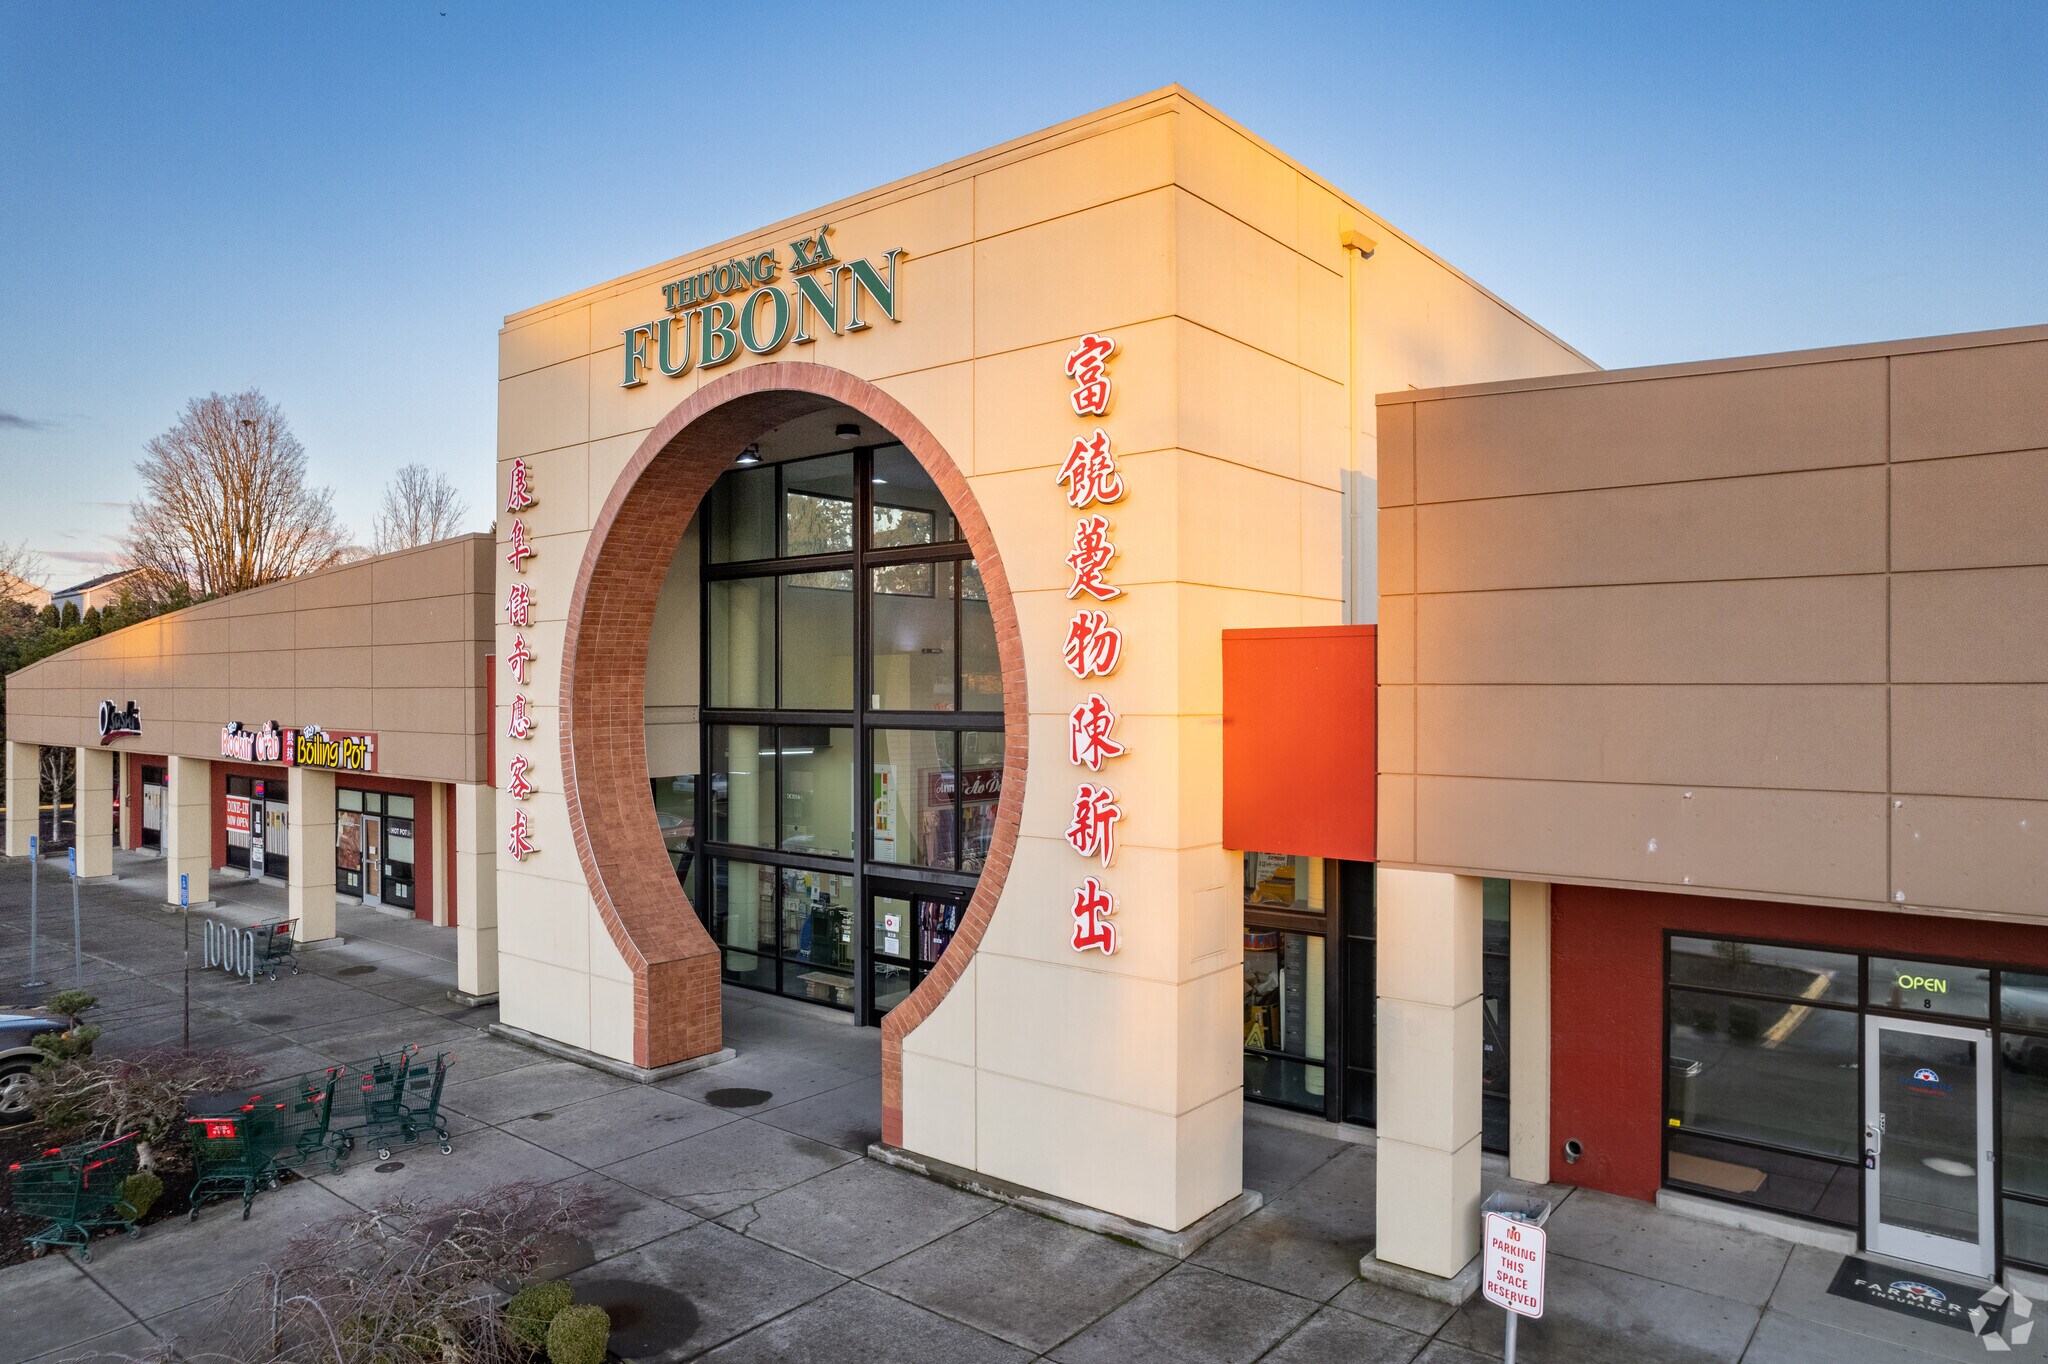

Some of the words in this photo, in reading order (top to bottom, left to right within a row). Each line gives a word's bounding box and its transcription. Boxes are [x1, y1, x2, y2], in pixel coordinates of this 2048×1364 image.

[620, 247, 903, 389] FUBONN
[222, 727, 254, 761] Rockin'
[256, 730, 279, 761] Crab
[297, 733, 339, 768] Boiling
[343, 737, 366, 770] Pot
[227, 800, 249, 815] DINE-IN
[237, 817, 249, 828] OPEN
[1899, 975, 1946, 993] OPEN
[1924, 999, 1932, 1009] 8
[1506, 1228, 1521, 1242] NO
[1492, 1237, 1536, 1262] PARKING
[1501, 1256, 1524, 1274] THIS
[1496, 1270, 1528, 1290] SPACE
[1487, 1280, 1537, 1308] RESERVED
[1854, 1278, 1981, 1317] FARMERS
[1871, 1290, 1958, 1318] INSURANCE
